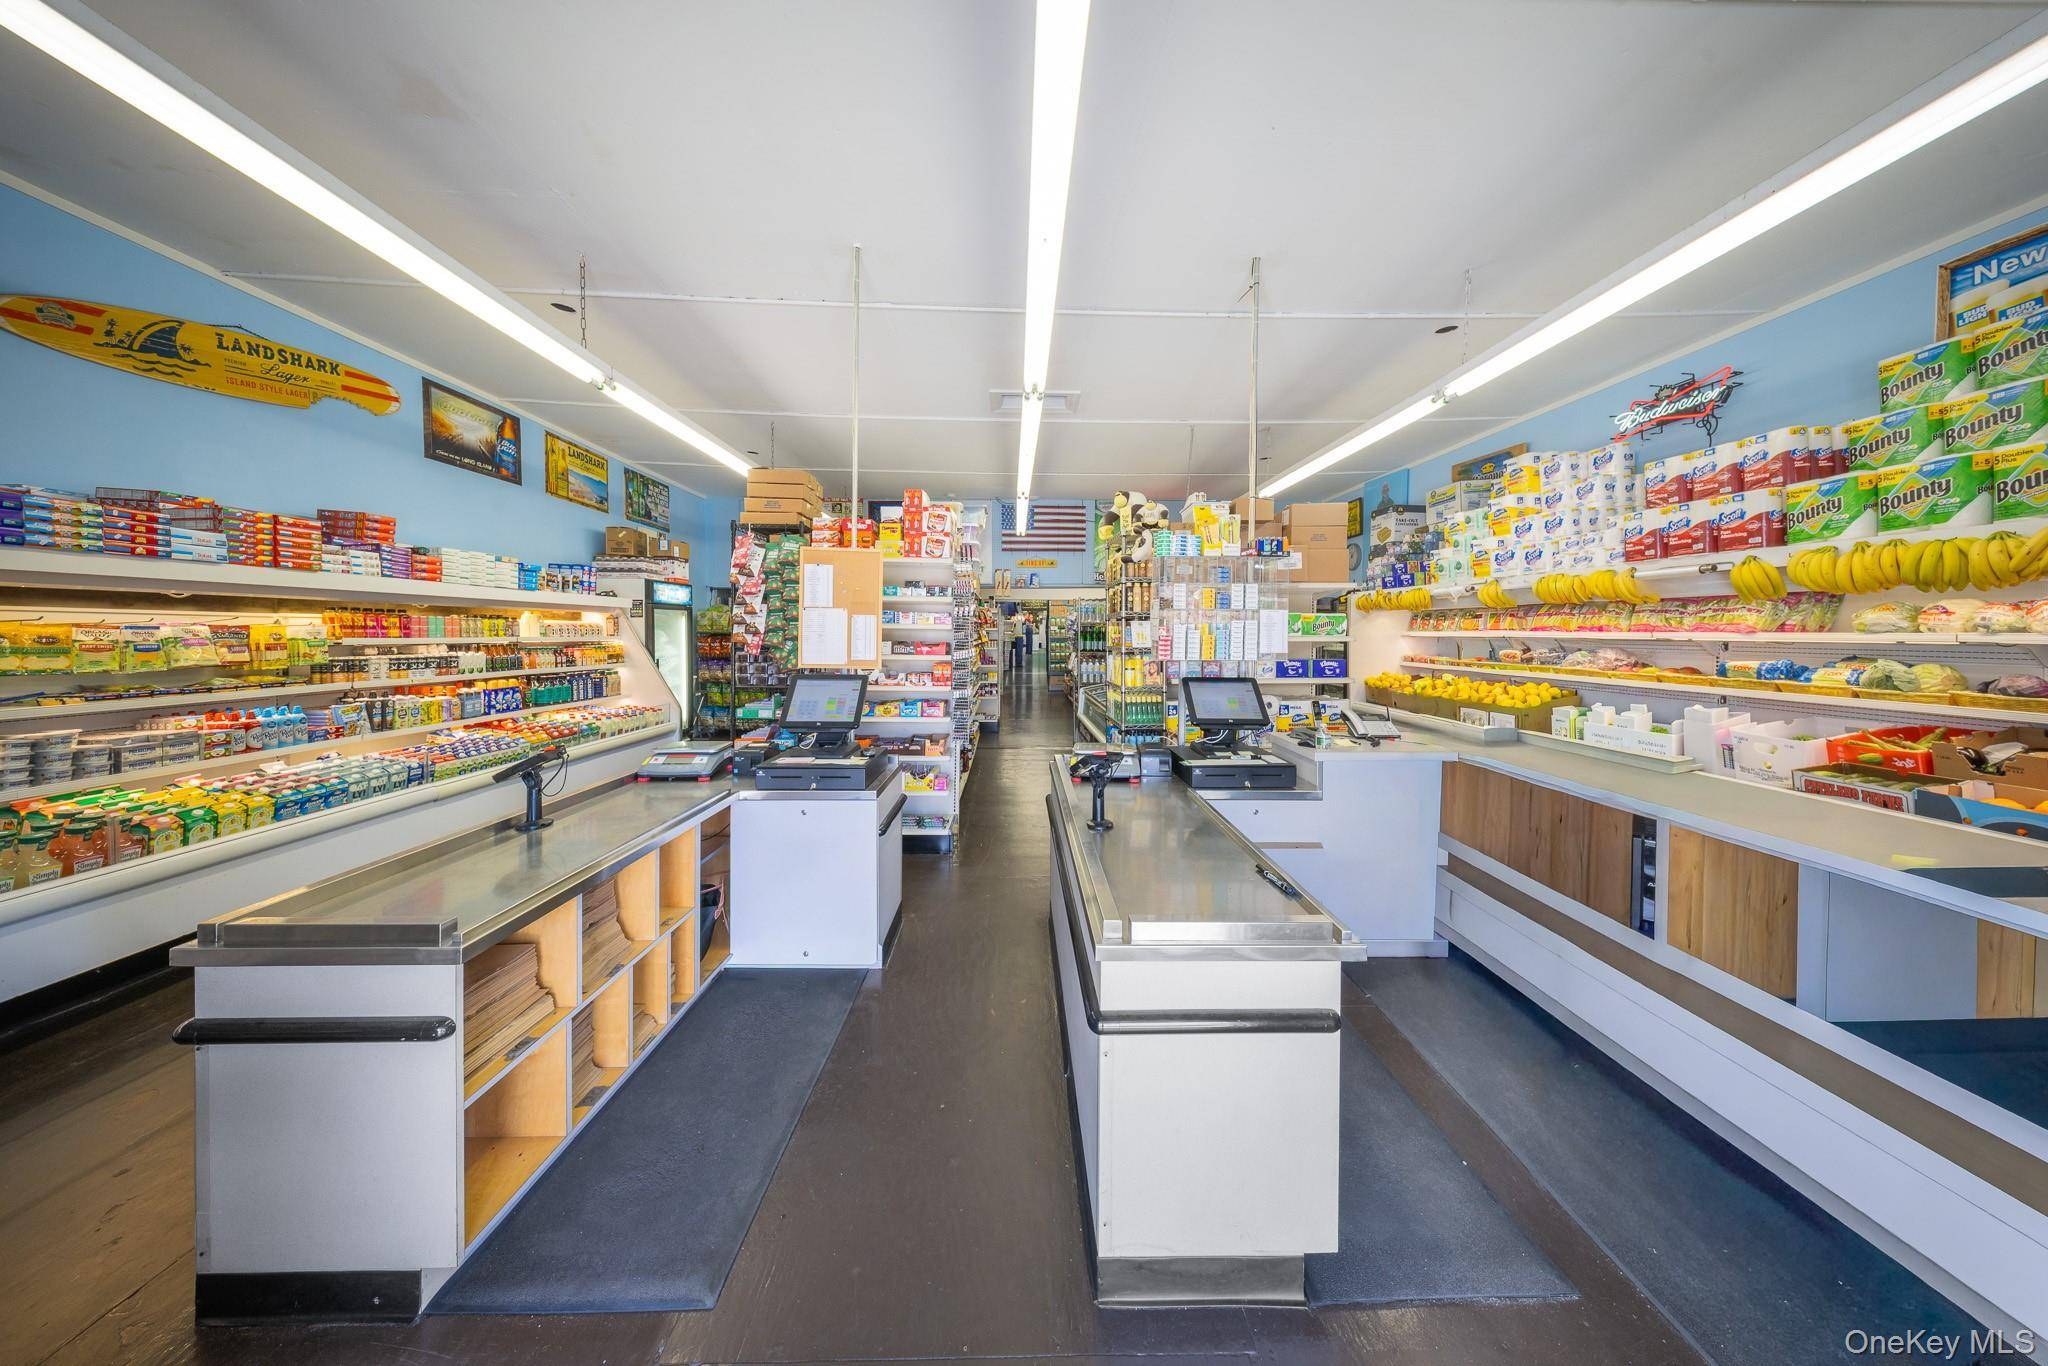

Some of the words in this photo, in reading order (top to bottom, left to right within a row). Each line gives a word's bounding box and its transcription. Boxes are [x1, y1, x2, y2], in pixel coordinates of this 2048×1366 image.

[1973, 245, 2048, 285] New
[1958, 310, 1988, 328] LIGH
[215, 331, 341, 377] LANDSHARK
[260, 363, 311, 384] Lager
[1880, 362, 1944, 406] Bounty
[1614, 384, 1727, 432] Budweiser
[1945, 404, 2023, 449] Bounty
[1850, 428, 1911, 465] Bounty
[568, 445, 605, 471] LANDSHARK
[1593, 450, 1614, 468] Scott
[1743, 449, 1769, 466] Scott
[1994, 455, 2001, 465] 5
[2000, 449, 2034, 460] Doubles
[1692, 461, 1717, 478] Scott
[1646, 473, 1666, 488] Scott
[1576, 481, 1595, 498] Scott
[1880, 478, 1952, 518] Bounty
[1545, 490, 1563, 507] Scott
[1544, 514, 1563, 531] Scott
[1718, 508, 1746, 526] Scott
[1788, 497, 1843, 531] Bounty
[1625, 525, 1643, 539] Scott
[1668, 517, 1691, 532] Scott
[1494, 549, 1515, 563] Scott
[1525, 547, 1543, 562] Scott
[1312, 620, 1335, 632] Bounty
[32, 869, 59, 881] Simply
